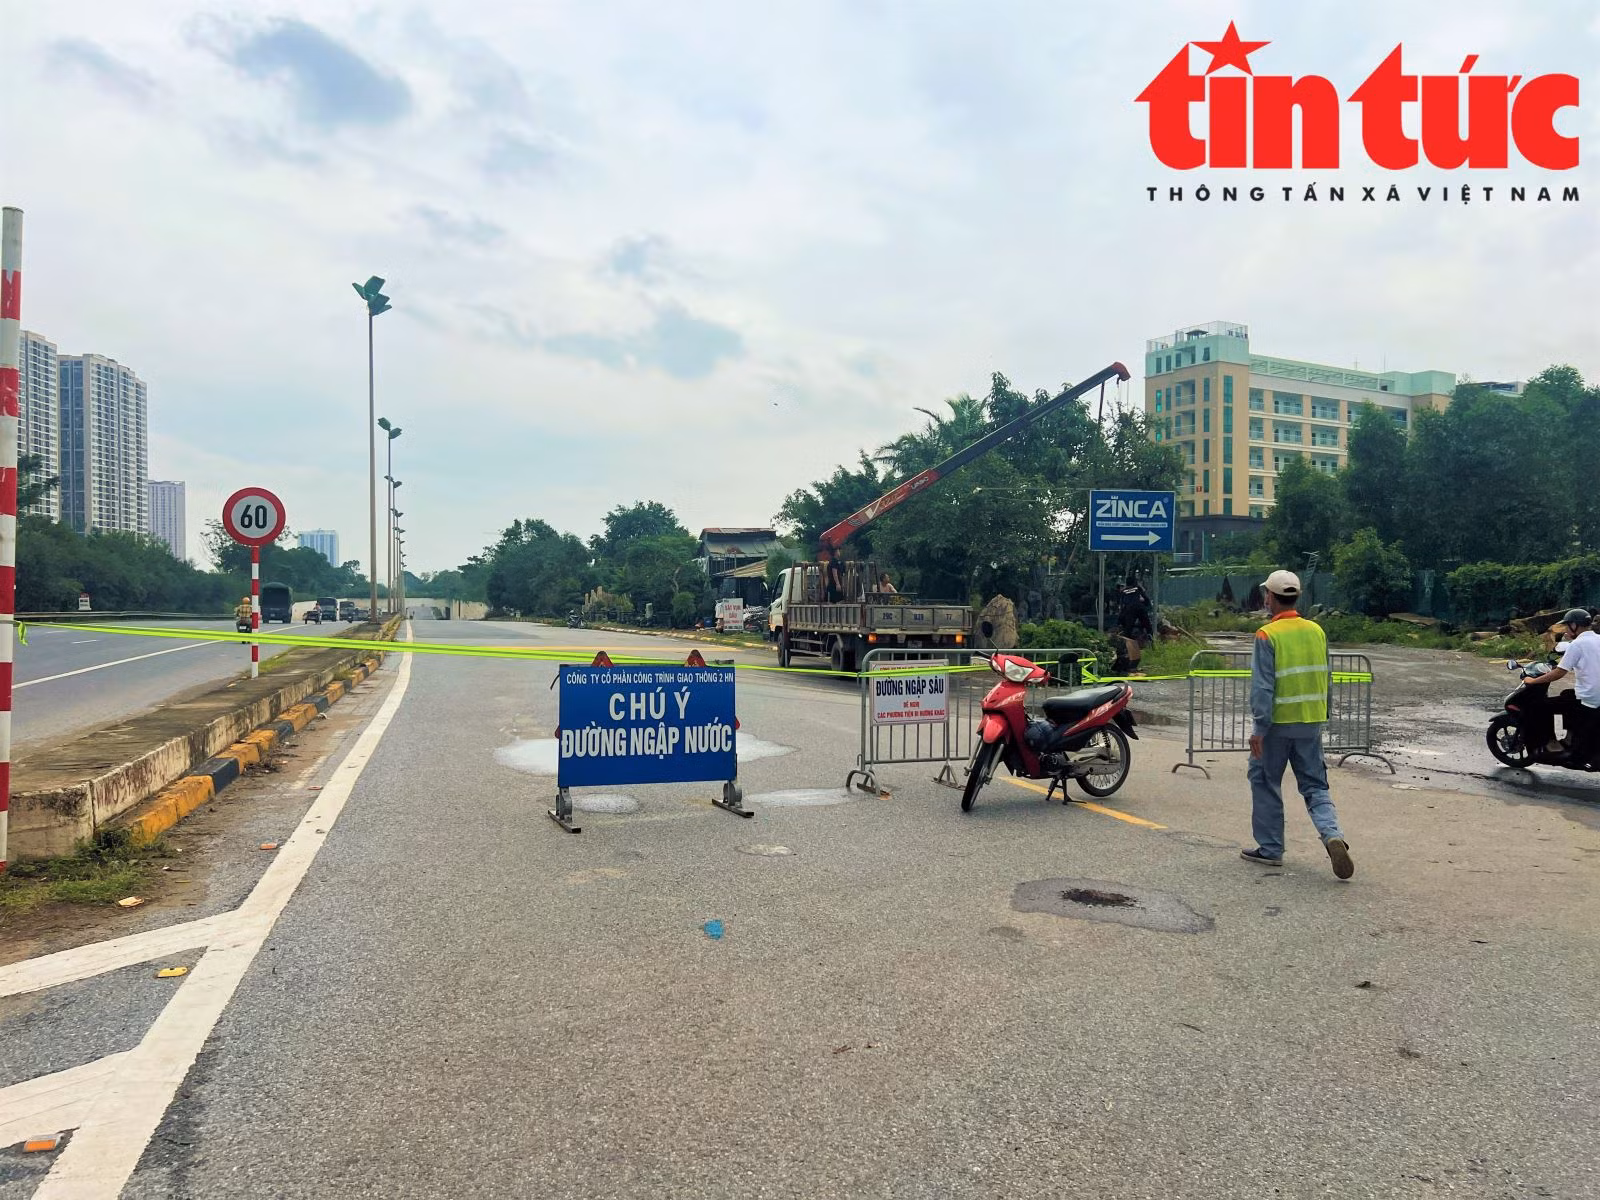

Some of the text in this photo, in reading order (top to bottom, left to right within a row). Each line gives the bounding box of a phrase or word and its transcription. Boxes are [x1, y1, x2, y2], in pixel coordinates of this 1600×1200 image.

[240, 504, 268, 529] 60
[1096, 496, 1167, 518] ZINCA
[566, 668, 734, 685] CÔNG TY CỔ PHẦN CÔNG TRÌNH GIAO THÔNG 2 HN
[876, 676, 944, 698] ĐƯỜNG NGẬP SÂU
[609, 686, 691, 720] CHÚ Ý
[561, 716, 732, 759] ĐƯỜNG NGẬP NƯỚC
